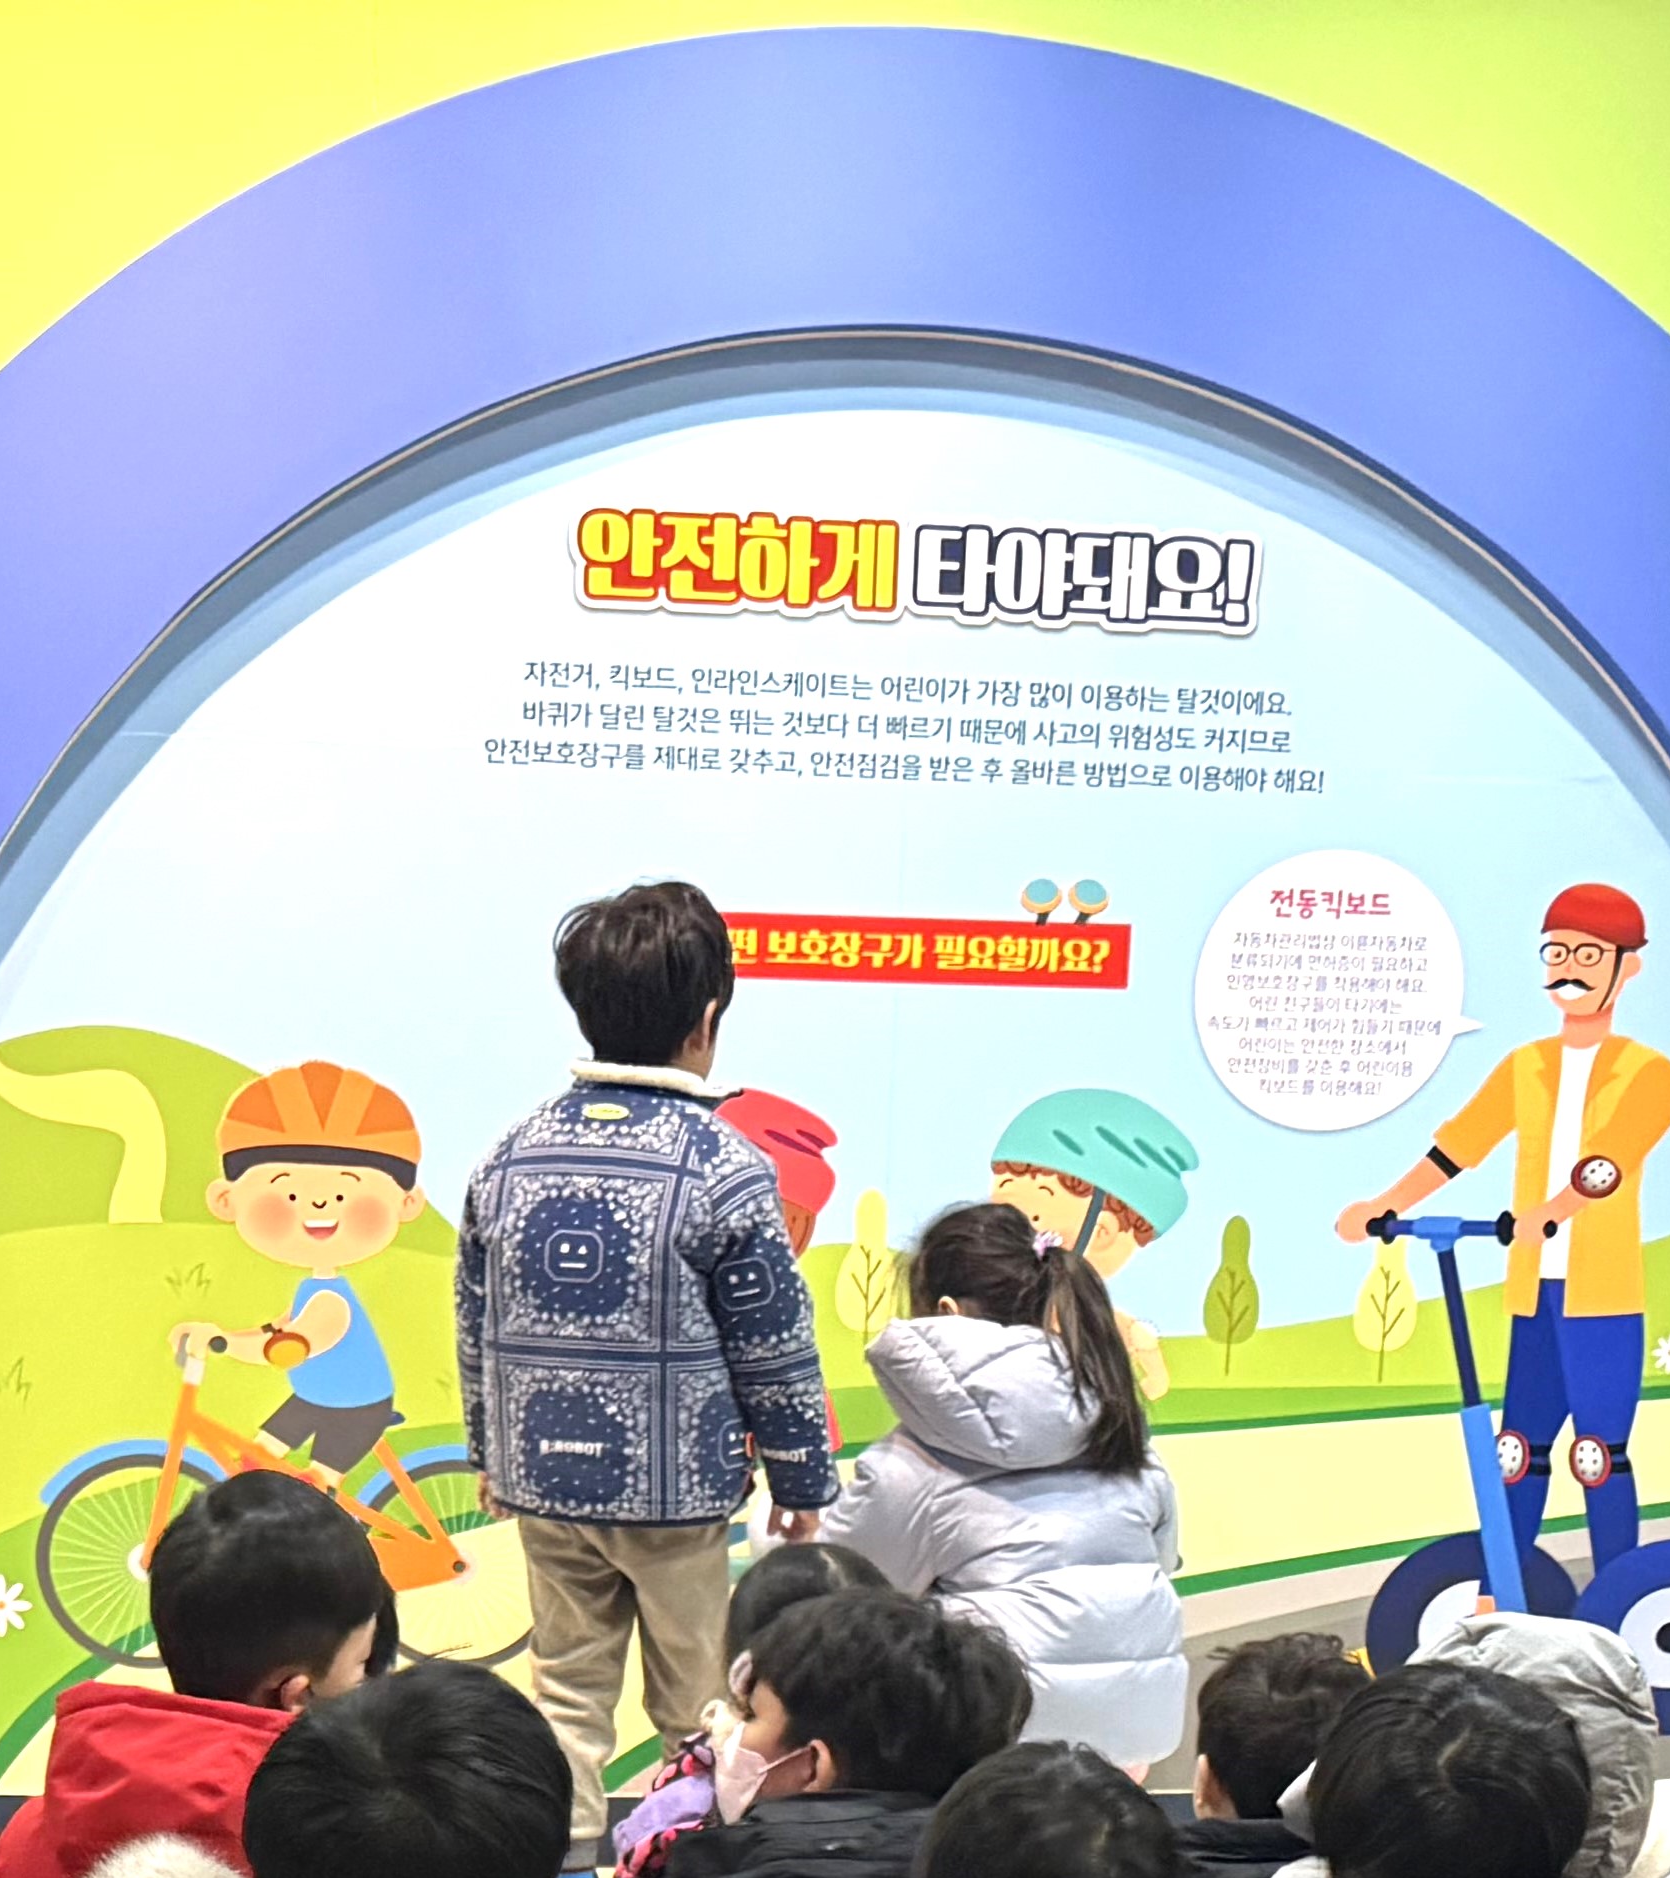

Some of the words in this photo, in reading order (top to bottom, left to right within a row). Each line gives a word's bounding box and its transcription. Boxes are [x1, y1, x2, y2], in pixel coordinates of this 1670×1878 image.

[578, 508, 899, 612] 안전하게
[913, 524, 1255, 626] 타야돼요!
[524, 661, 600, 691] 자전거,
[609, 664, 683, 695] 킥보드,
[692, 667, 873, 700] 인라인스케이트는
[881, 674, 970, 705] 어린이가
[977, 680, 1022, 708] 가장
[1030, 681, 1072, 709] 많이
[1081, 683, 1170, 713] 이용하는
[1177, 687, 1293, 717] 탈것이에요.
[522, 701, 593, 728] 바퀴가
[600, 704, 644, 731] 달린
[653, 706, 720, 734] 탈것은
[729, 709, 774, 736] 뛰는
[783, 711, 849, 738] 것보다
[857, 714, 879, 740] 더
[886, 715, 952, 742] 빠르기
[961, 718, 1026, 746] 때문에
[1033, 721, 1100, 749] 사고의
[1108, 724, 1196, 751] 위험성도
[1204, 728, 1292, 754] 커지므로
[484, 738, 644, 770] 안전보호장구를
[653, 746, 721, 772] 제대로
[729, 748, 803, 778] 갖추고,
[810, 751, 922, 781] 안전점검을
[929, 756, 974, 782] 받은
[981, 757, 1004, 782] 후
[1011, 759, 1077, 786] 올바른
[1083, 762, 1172, 788] 방법으로
[1180, 765, 1269, 793] 이용해야
[1274, 768, 1325, 795] 해요!
[1270, 888, 1391, 919] 전동킥보드
[728, 929, 758, 965] 떤
[767, 930, 925, 969] 보호장구가
[934, 934, 1111, 974] 필요할까요?
